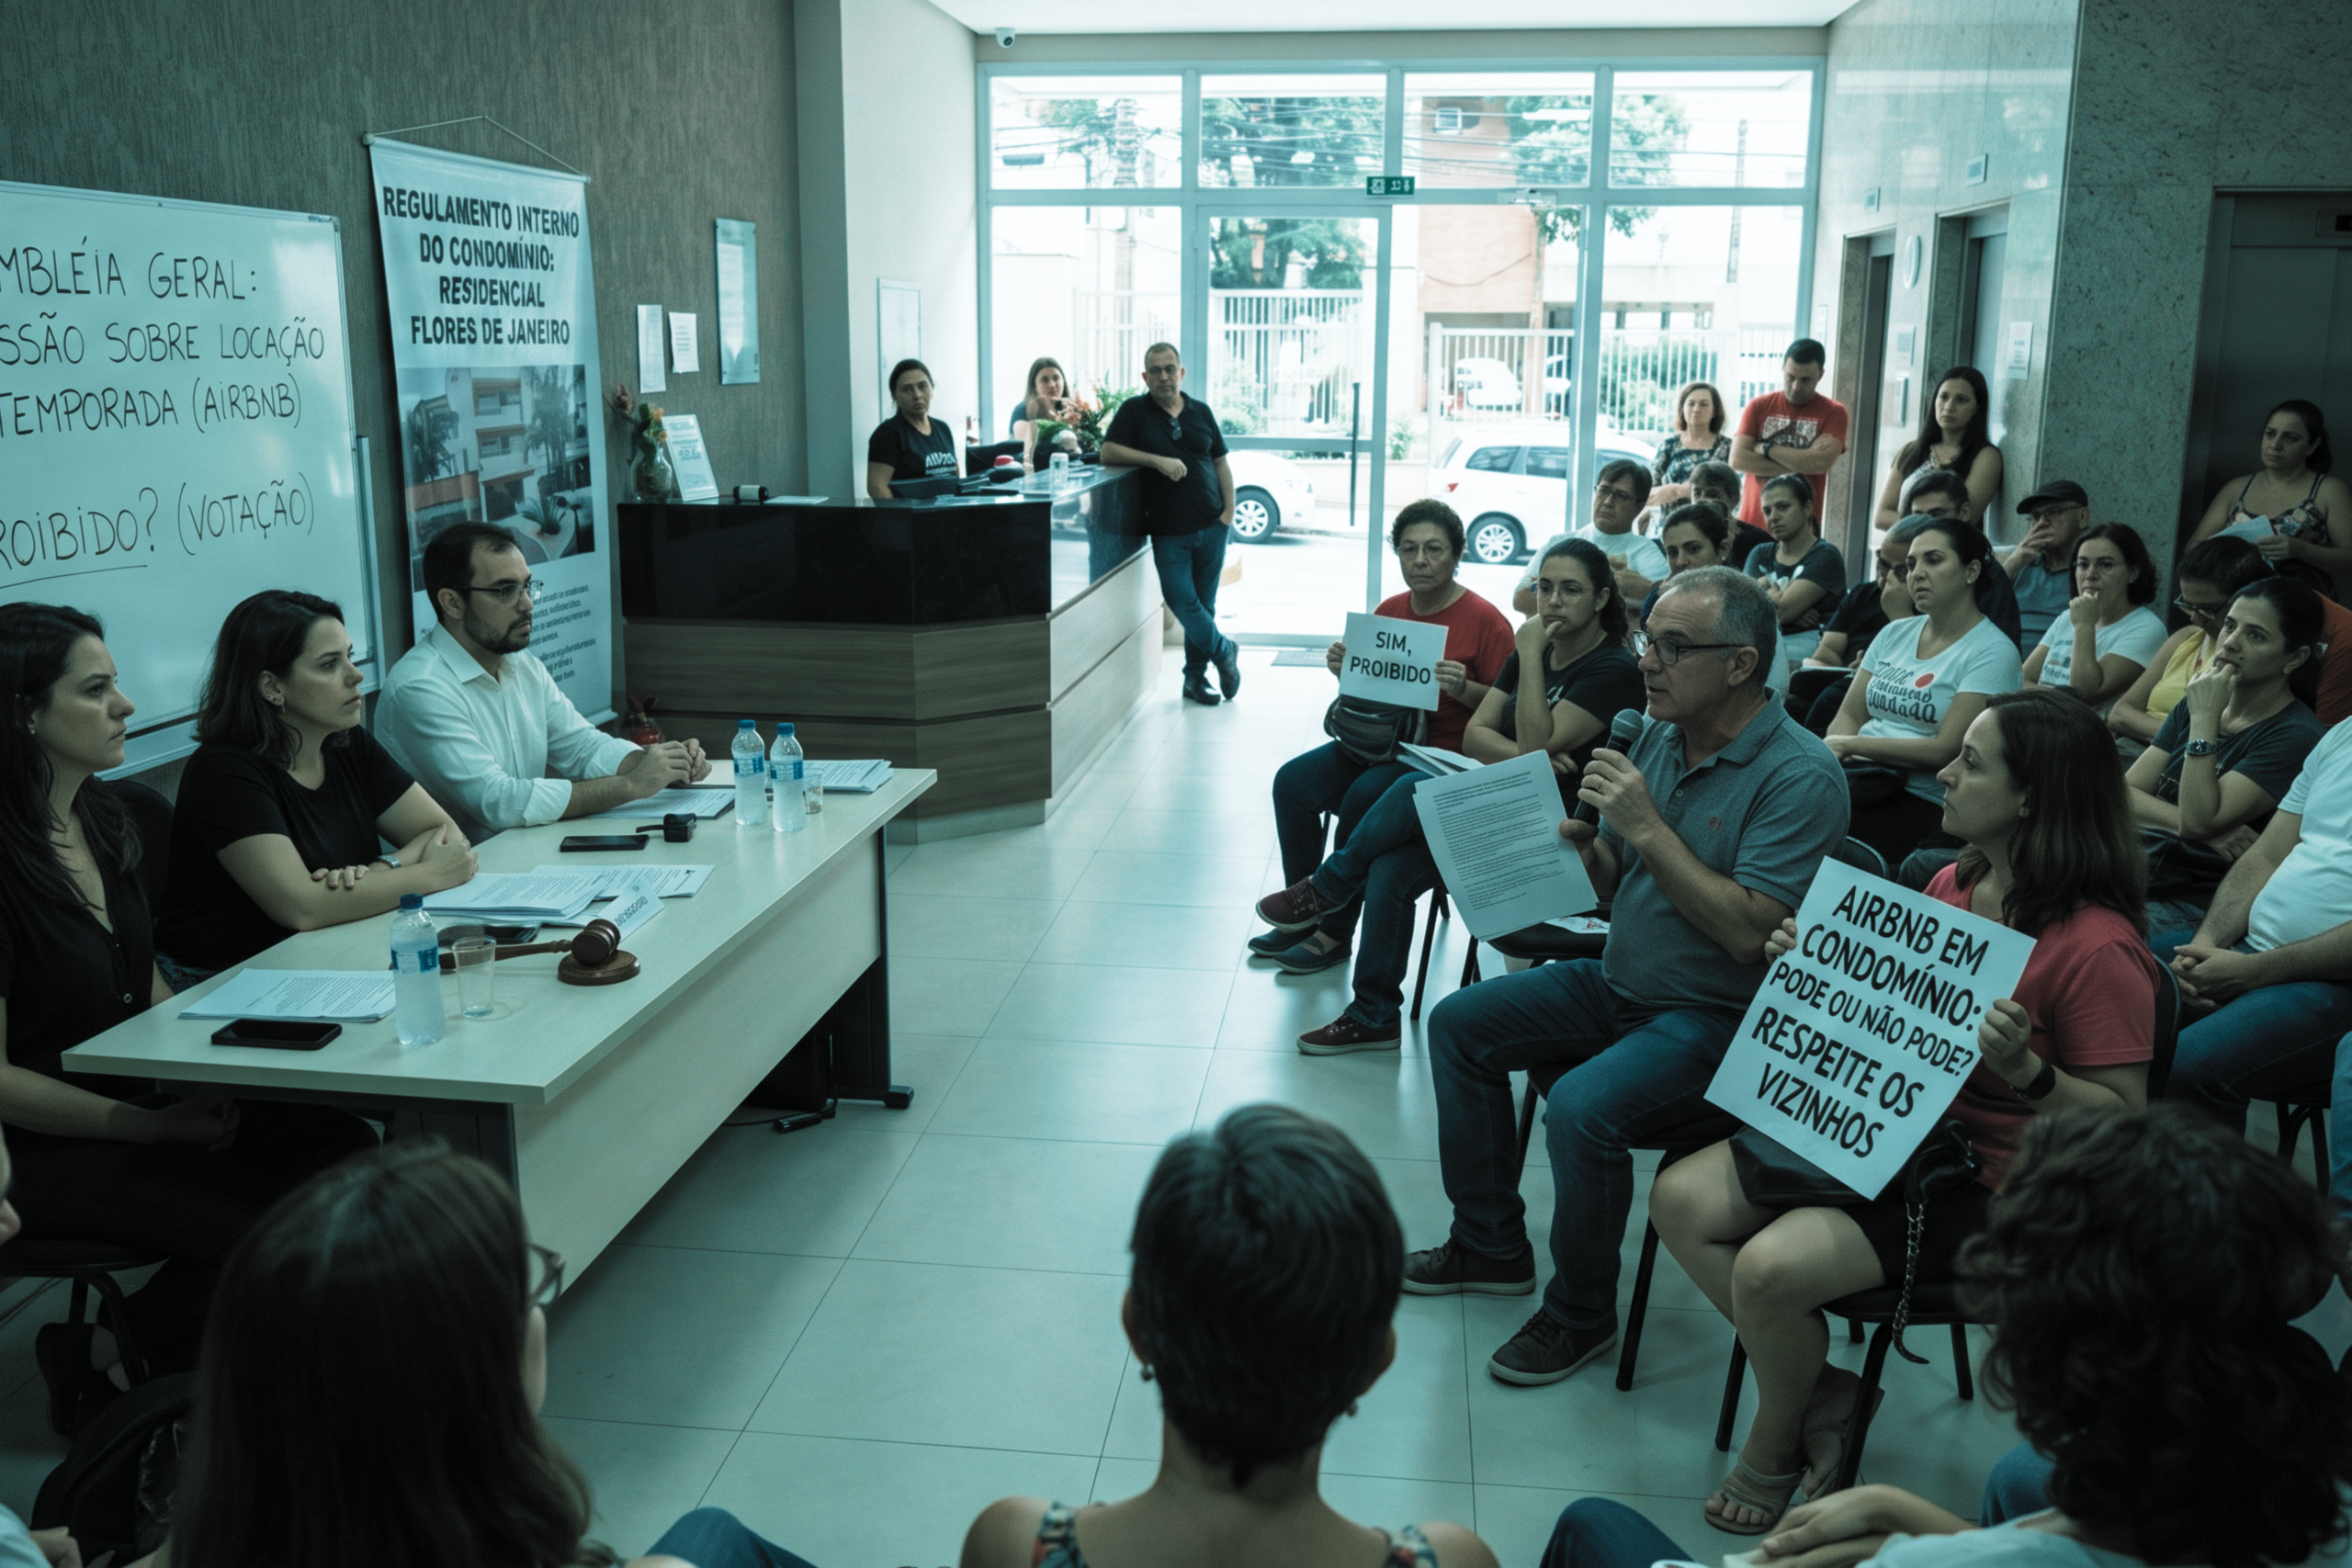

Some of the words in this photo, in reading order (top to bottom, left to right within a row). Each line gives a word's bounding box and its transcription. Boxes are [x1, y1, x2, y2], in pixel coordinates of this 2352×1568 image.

[383, 186, 513, 231] REGULAMENTO
[516, 205, 580, 238] INTERNO
[149, 252, 257, 299] GERAL:
[420, 233, 444, 264] DO
[449, 235, 554, 272] CONDOMÍNIO:
[439, 276, 545, 308] RESIDENCIAL
[0, 311, 85, 365] SSÃO
[106, 322, 200, 363] SOBRE
[220, 316, 324, 367] LOCAÇÃO
[411, 316, 478, 344] FLORES
[481, 318, 503, 344] DE
[507, 319, 570, 344] JANEIRO
[178, 472, 314, 555] (VOTAÇÃO)
[1350, 656, 1430, 684] PROIBIDO
[1375, 631, 1411, 657] SIM,
[1832, 885, 1939, 953] AIRBNB
[1939, 927, 1989, 976] EM
[1802, 923, 1981, 1032] CONDOMÍNIO:
[1770, 961, 1830, 1010] PODE
[1828, 990, 1862, 1023] OU
[1859, 1005, 1905, 1044] NÃO
[1903, 1026, 1973, 1077] PODE?
[1751, 1006, 1882, 1098] RESPEITE
[1880, 1072, 1925, 1118] OS
[1757, 1062, 1884, 1157] VIZINHOS
